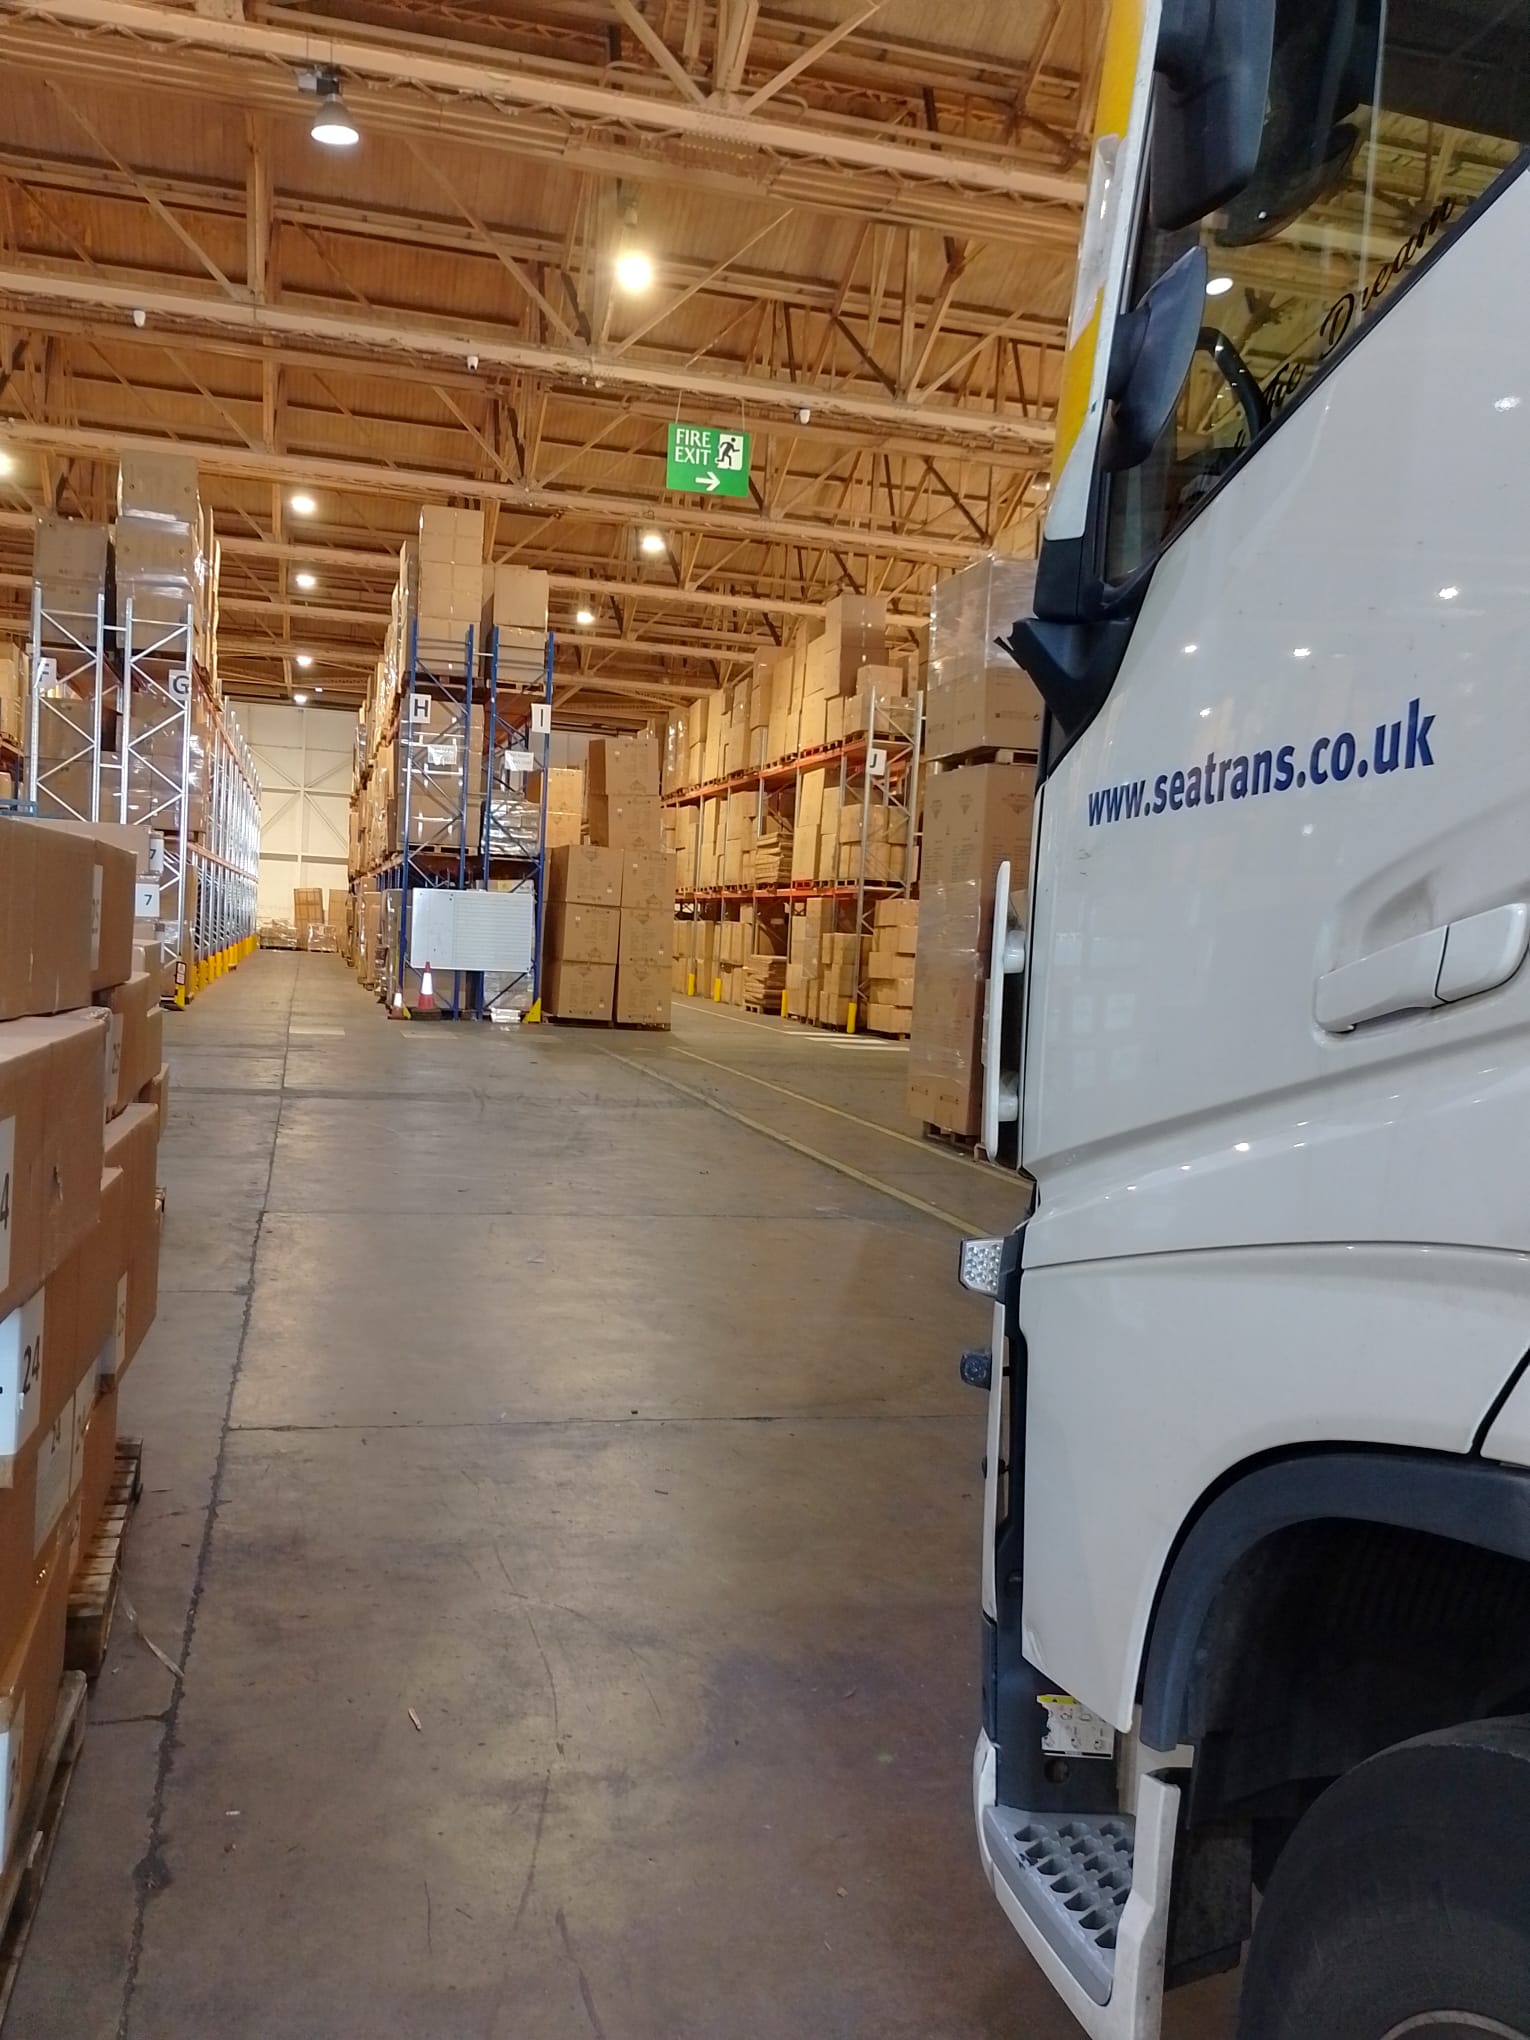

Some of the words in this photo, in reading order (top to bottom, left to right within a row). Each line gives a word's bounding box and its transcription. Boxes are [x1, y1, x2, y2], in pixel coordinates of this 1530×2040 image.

[1319, 196, 1456, 361] Dream
[676, 428, 711, 448] FIRE
[675, 446, 711, 465] EXIT
[172, 675, 190, 694] G
[414, 698, 429, 717] H
[869, 753, 877, 768] J
[1088, 697, 1436, 827] www.seatrans.co.uk
[144, 895, 152, 906] 7
[22, 1335, 41, 1395] 24
